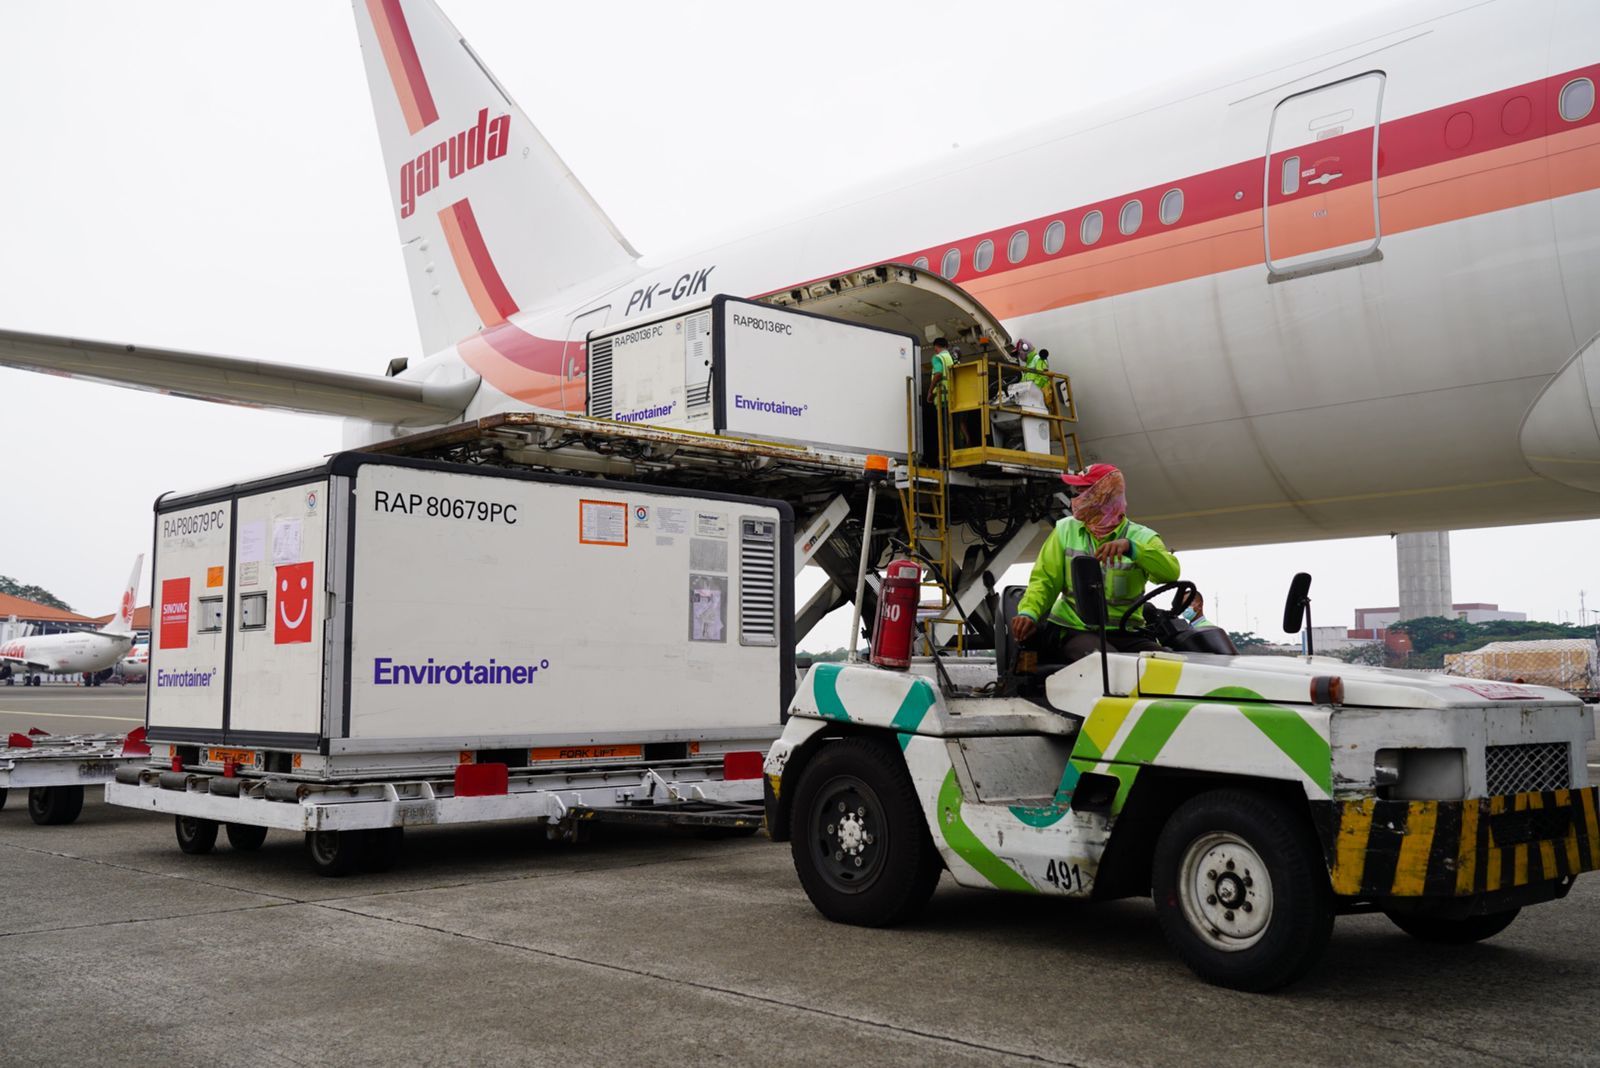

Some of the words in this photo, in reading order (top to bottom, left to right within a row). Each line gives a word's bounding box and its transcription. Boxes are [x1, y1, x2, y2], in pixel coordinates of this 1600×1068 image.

[401, 107, 511, 219] garuda
[625, 265, 716, 317] PK-GIK
[733, 314, 792, 336] RAP80136PC
[163, 602, 188, 614] SINOVAC
[560, 749, 590, 759] FORK
[593, 748, 617, 758] LIFT
[1046, 858, 1083, 893] 491
